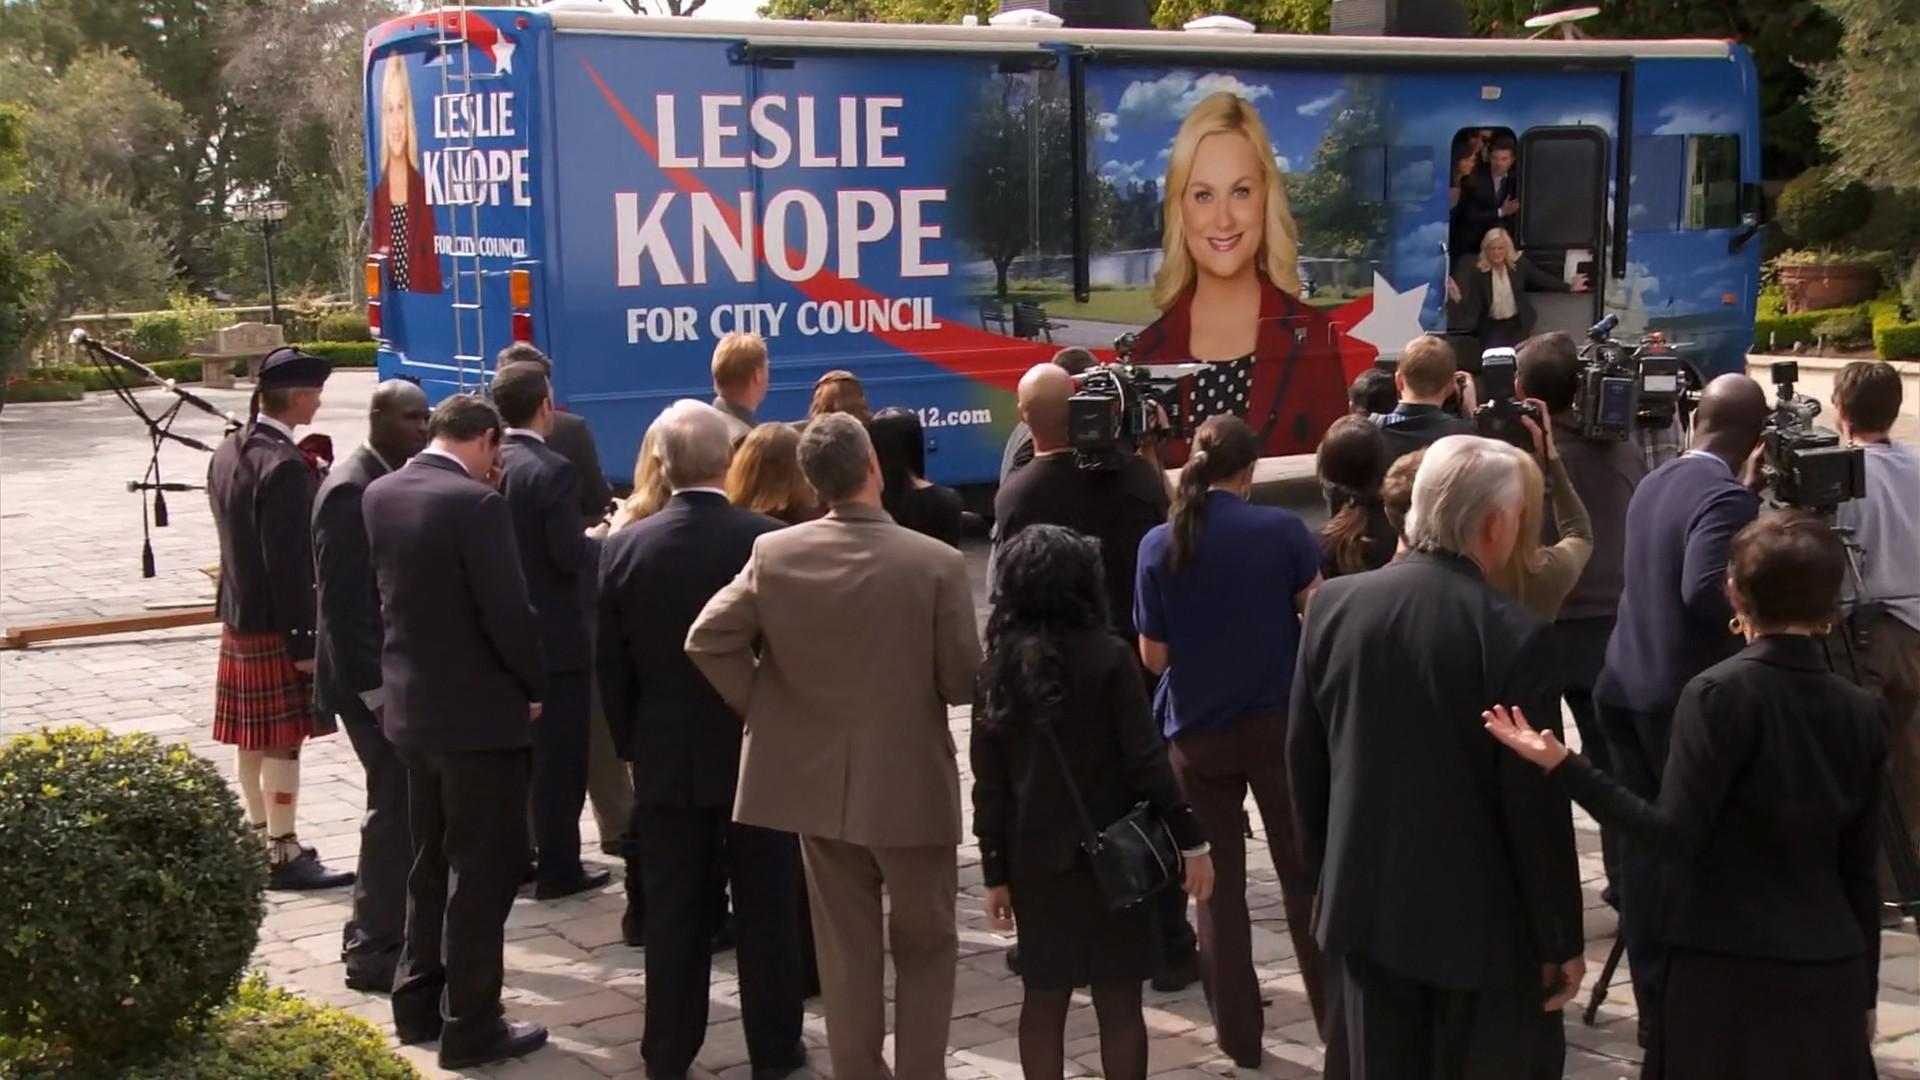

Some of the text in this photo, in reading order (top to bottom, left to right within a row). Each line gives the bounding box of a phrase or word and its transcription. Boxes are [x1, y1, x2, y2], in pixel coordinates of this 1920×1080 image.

[433, 92, 516, 139] LESLIE
[656, 94, 906, 169] LESLIE
[423, 149, 532, 207] KNOPE
[434, 235, 452, 255] FOR
[480, 237, 527, 259] COUNCIL
[614, 188, 950, 287] KNOPE
[627, 297, 942, 344] FOR CITY COUNCIL
[908, 407, 992, 428] 12.com
